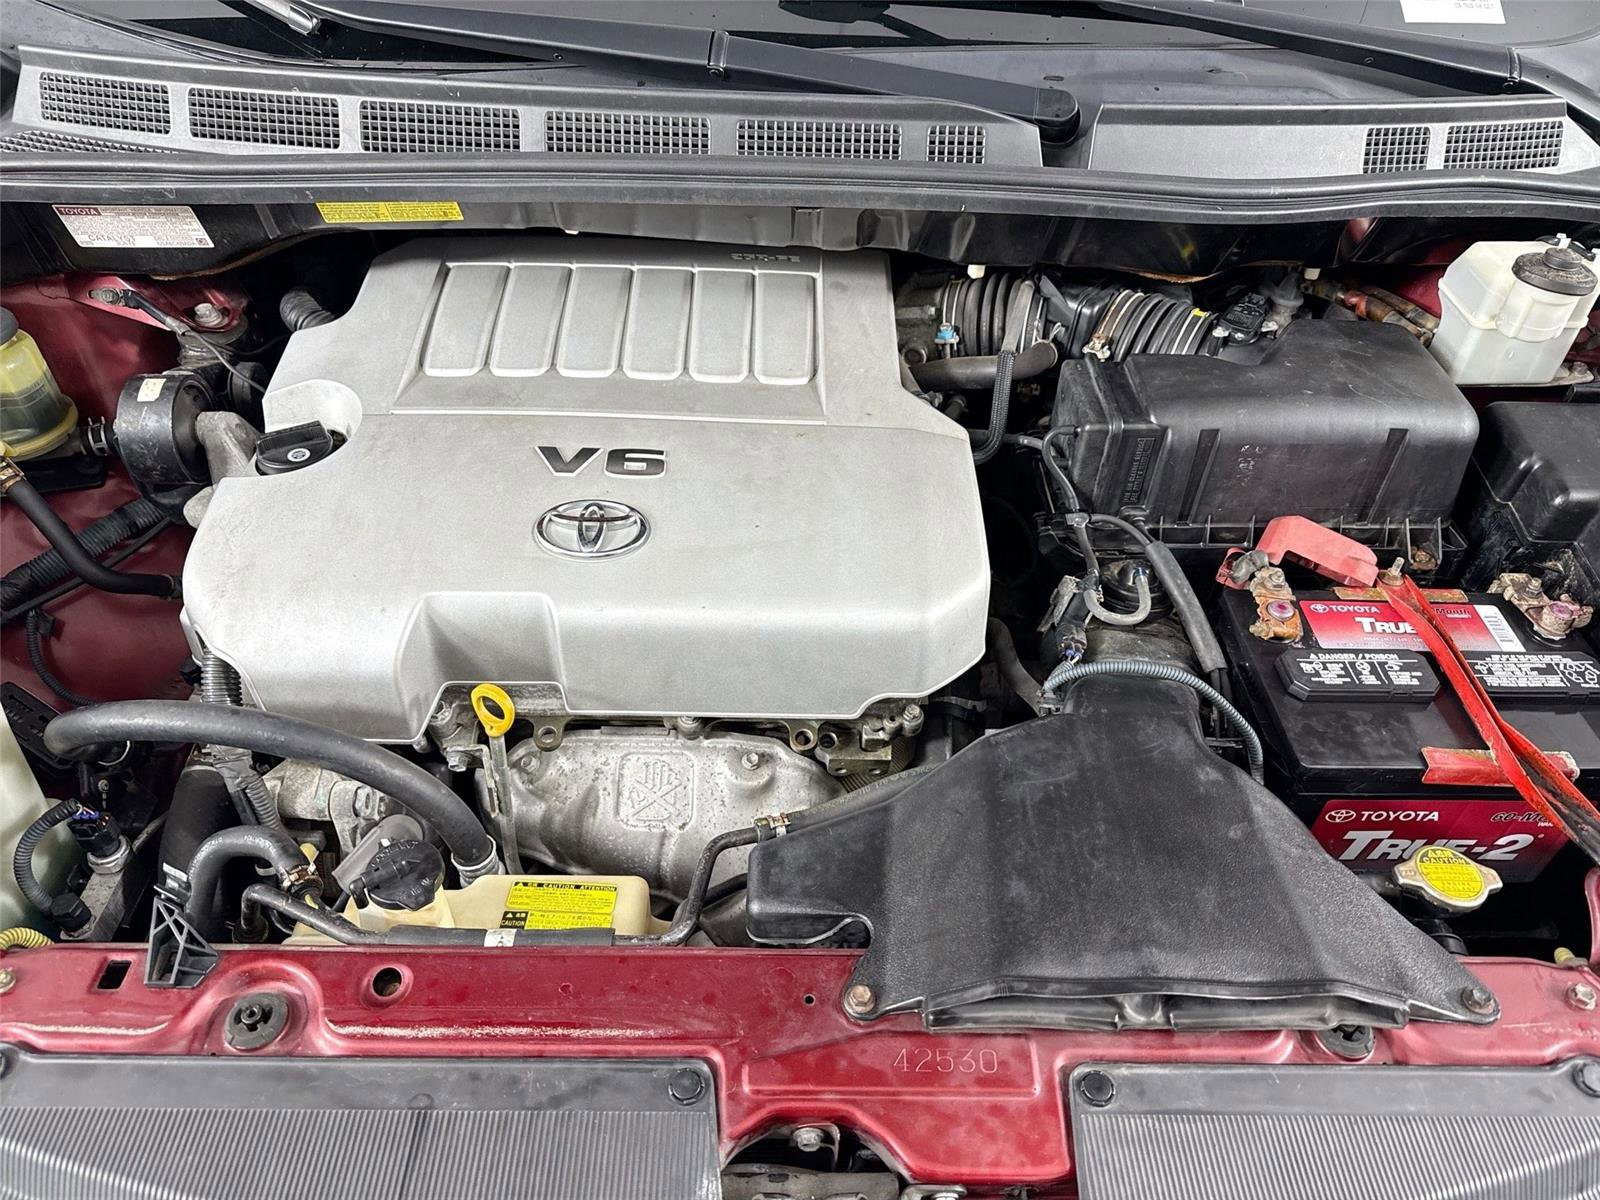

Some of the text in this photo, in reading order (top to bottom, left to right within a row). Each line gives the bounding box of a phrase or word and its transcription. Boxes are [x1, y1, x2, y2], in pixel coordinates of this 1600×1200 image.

[535, 446, 667, 478] V6
[1330, 604, 1380, 614] TOYOTA
[1360, 810, 1439, 822] TOYOTA
[1423, 857, 1466, 865] CAUTION
[893, 1048, 998, 1073] 42530
